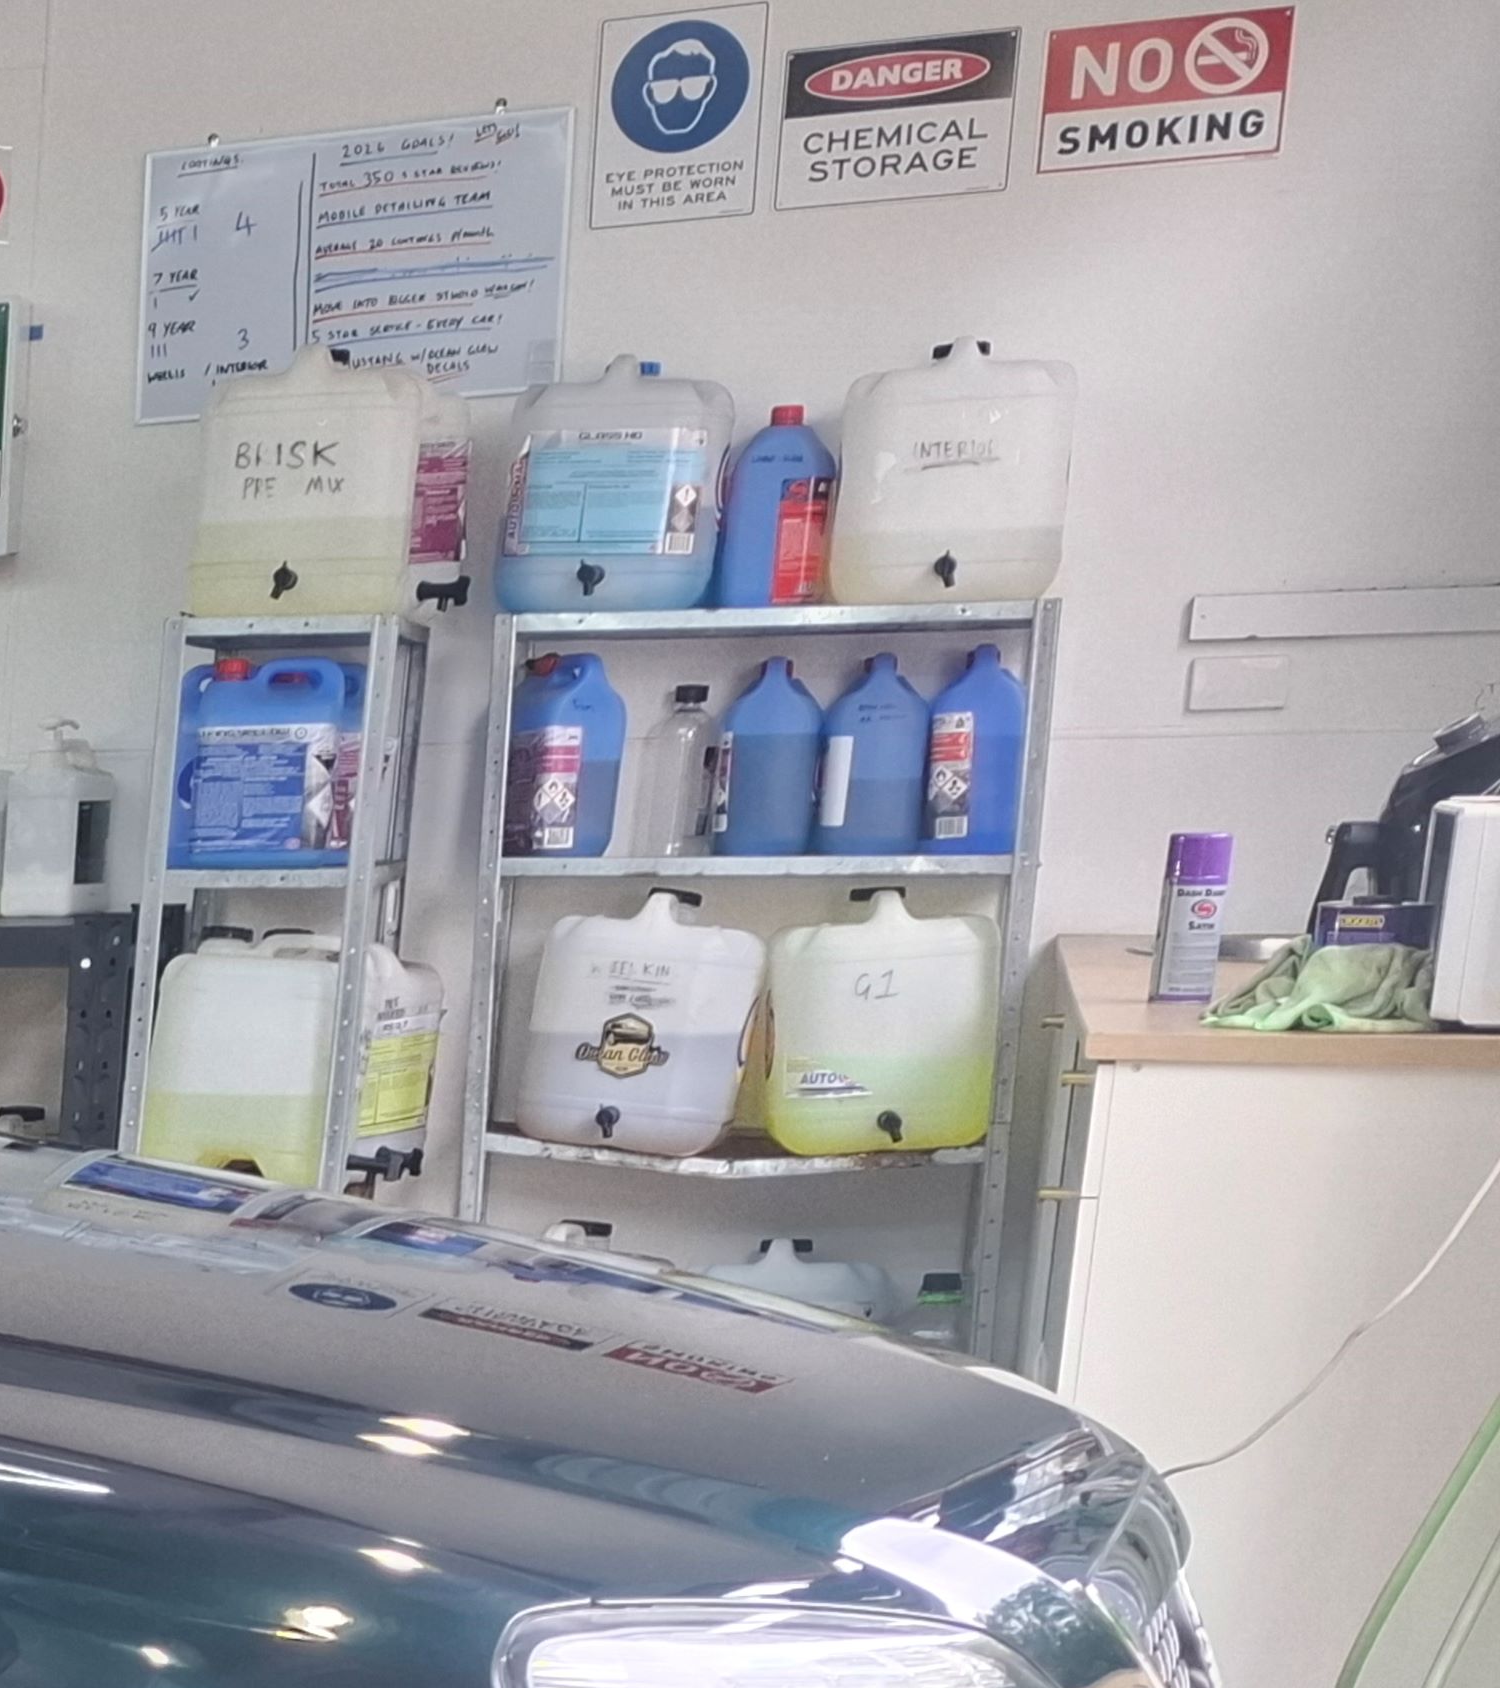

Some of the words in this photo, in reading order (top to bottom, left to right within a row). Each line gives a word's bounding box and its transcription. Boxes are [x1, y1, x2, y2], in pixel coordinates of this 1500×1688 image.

[829, 58, 964, 92] DANGER
[1069, 38, 1174, 99] NO
[802, 116, 989, 157] CHEMICAL
[1056, 107, 1266, 157] SMOKING
[605, 170, 636, 184] EYE
[643, 159, 745, 180] PROTECTION
[806, 147, 978, 184] STORAGE
[363, 170, 395, 188] 350
[611, 182, 654, 198] MUST
[661, 180, 683, 193] BE
[690, 175, 737, 190] WORN
[317, 206, 366, 224] MOBILE
[454, 190, 491, 205] TEAM
[617, 200, 634, 211] IN
[640, 195, 676, 209] THIS
[682, 190, 728, 206] AREA
[160, 206, 168, 222] 5
[153, 272, 163, 285] 7
[169, 268, 199, 284] YEAR
[163, 320, 196, 337] YEAR
[237, 327, 250, 351] 3
[312, 329, 321, 343] 5
[426, 316, 464, 330] EVERY
[346, 351, 404, 369] USTANG
